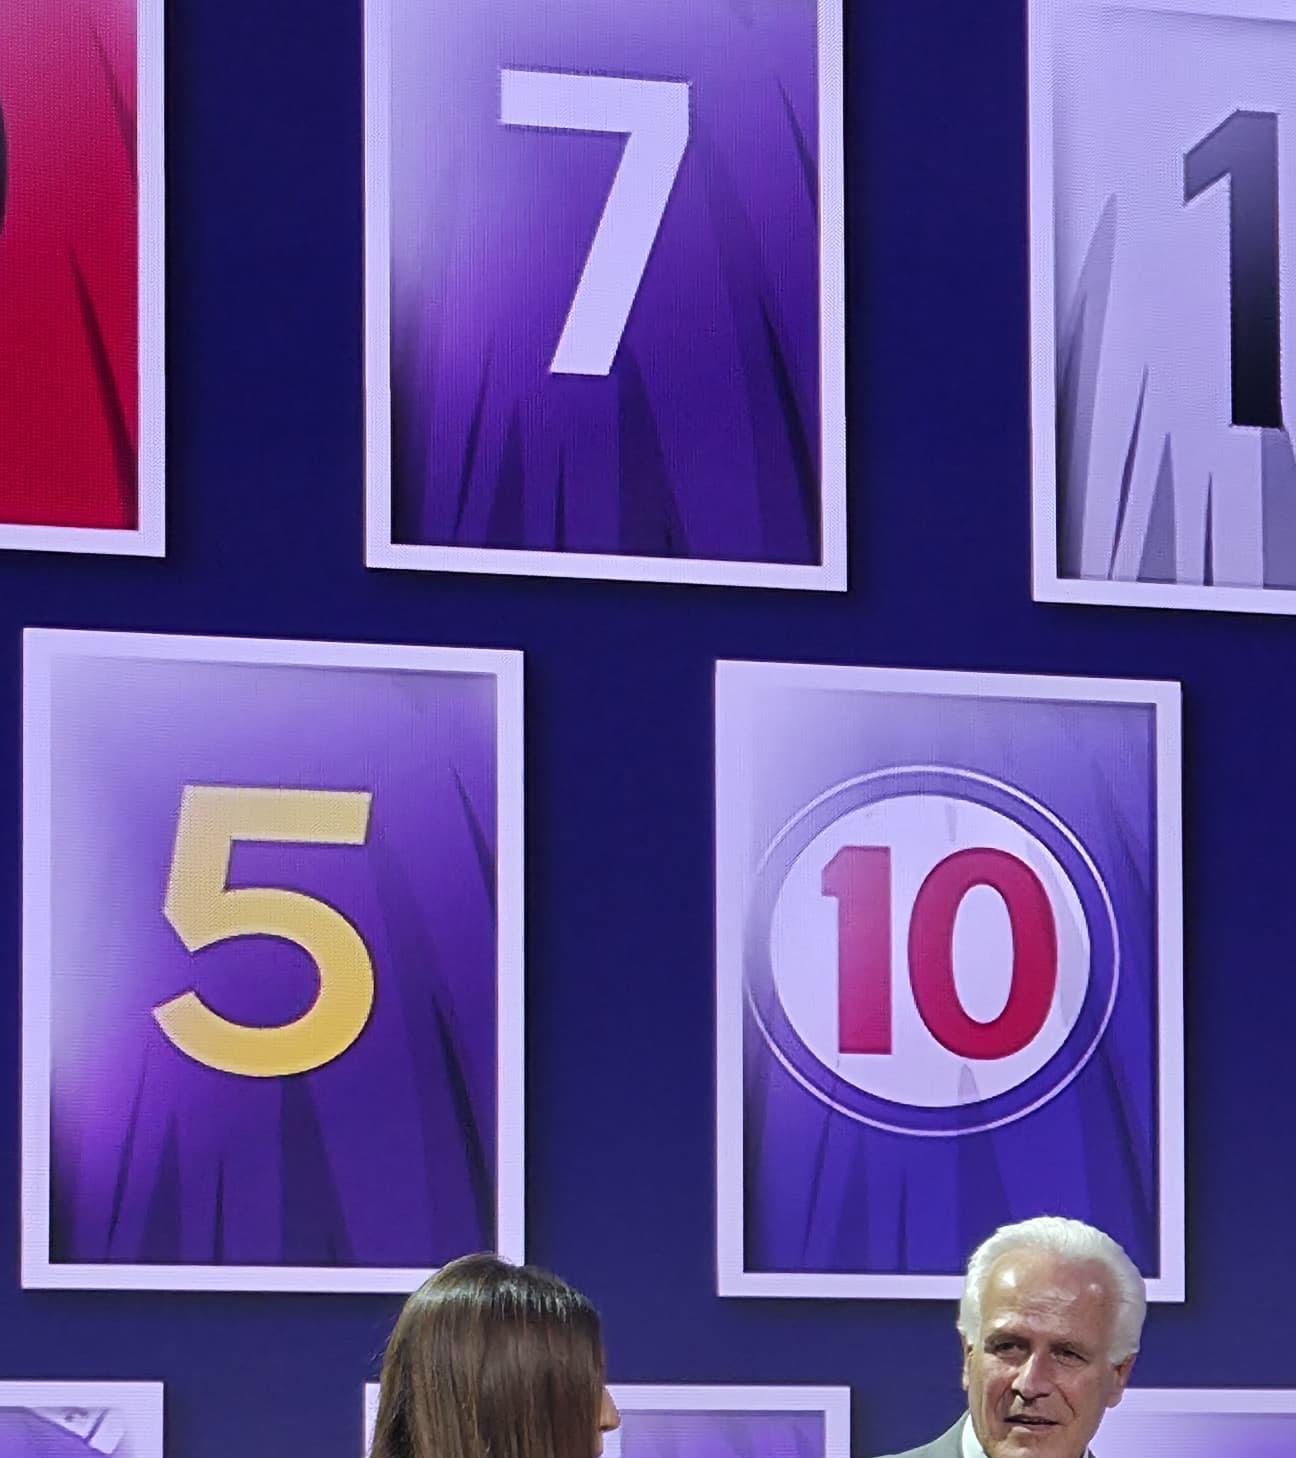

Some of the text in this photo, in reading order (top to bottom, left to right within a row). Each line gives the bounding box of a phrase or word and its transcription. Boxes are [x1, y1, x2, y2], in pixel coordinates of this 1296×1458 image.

[500, 69, 690, 376] 7
[1183, 109, 1284, 429] 1
[152, 785, 375, 1078] 5
[820, 845, 1058, 1060] 10
